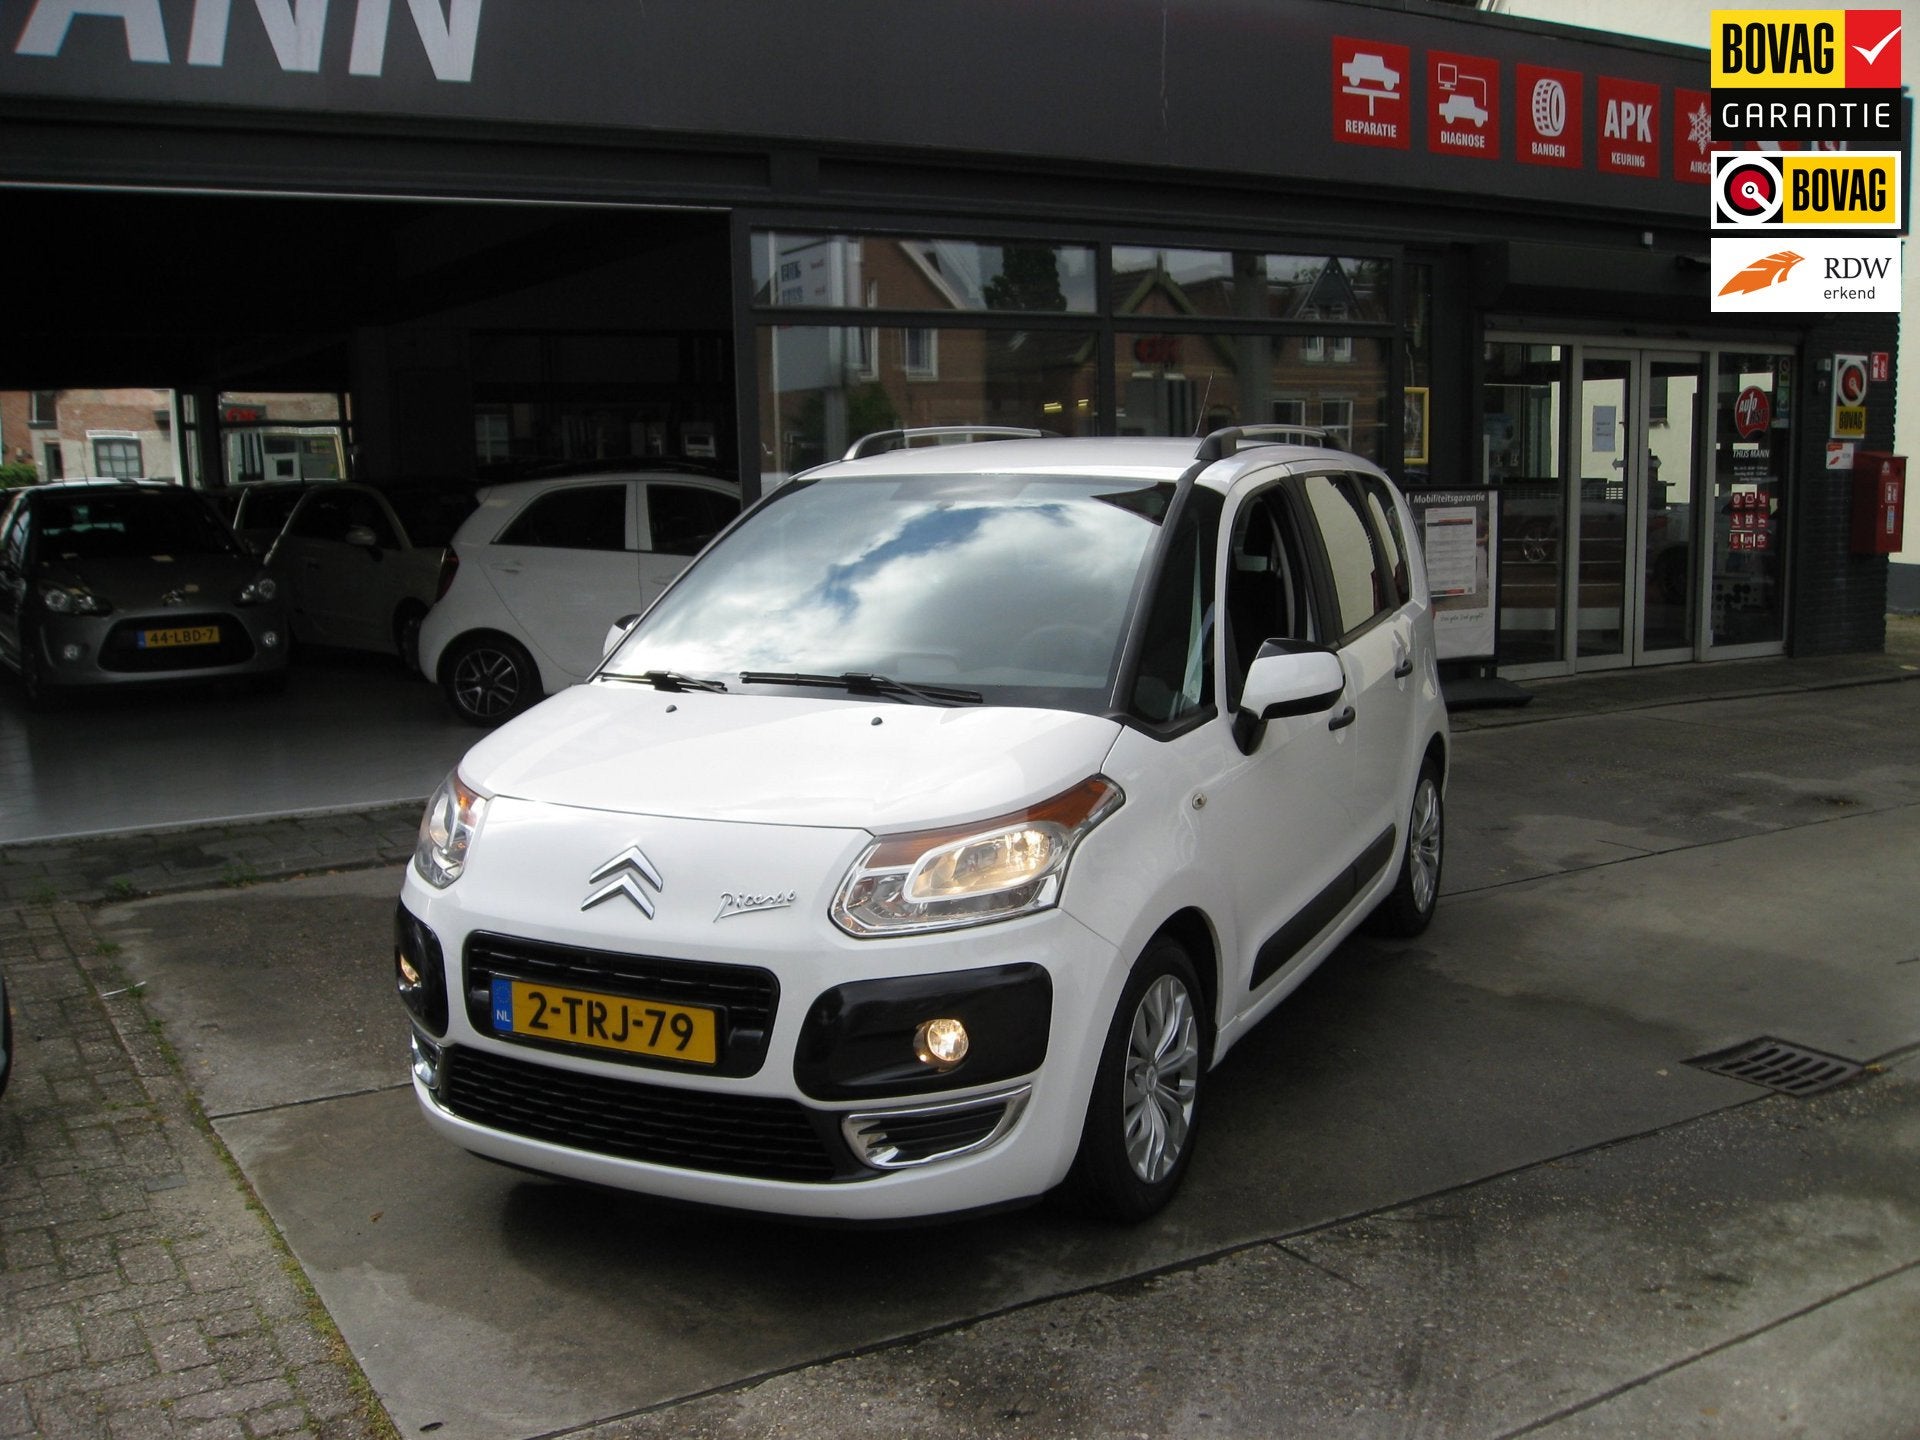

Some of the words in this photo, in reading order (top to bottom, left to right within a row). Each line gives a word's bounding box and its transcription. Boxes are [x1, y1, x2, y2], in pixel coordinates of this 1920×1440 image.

[1345, 119, 1397, 138] REPARATIE
[1604, 98, 1653, 143] APK
[1440, 130, 1485, 148] DIAGNOSE
[1531, 141, 1566, 158] BANDEN
[1611, 151, 1645, 168] KEURING
[1839, 411, 1863, 430] BOVAG
[1413, 492, 1486, 504] Mobiliteitsgarantie
[150, 628, 214, 644] 44-LBD-7
[496, 1009, 511, 1023] NL
[528, 991, 694, 1051] 2-TRJ-79
